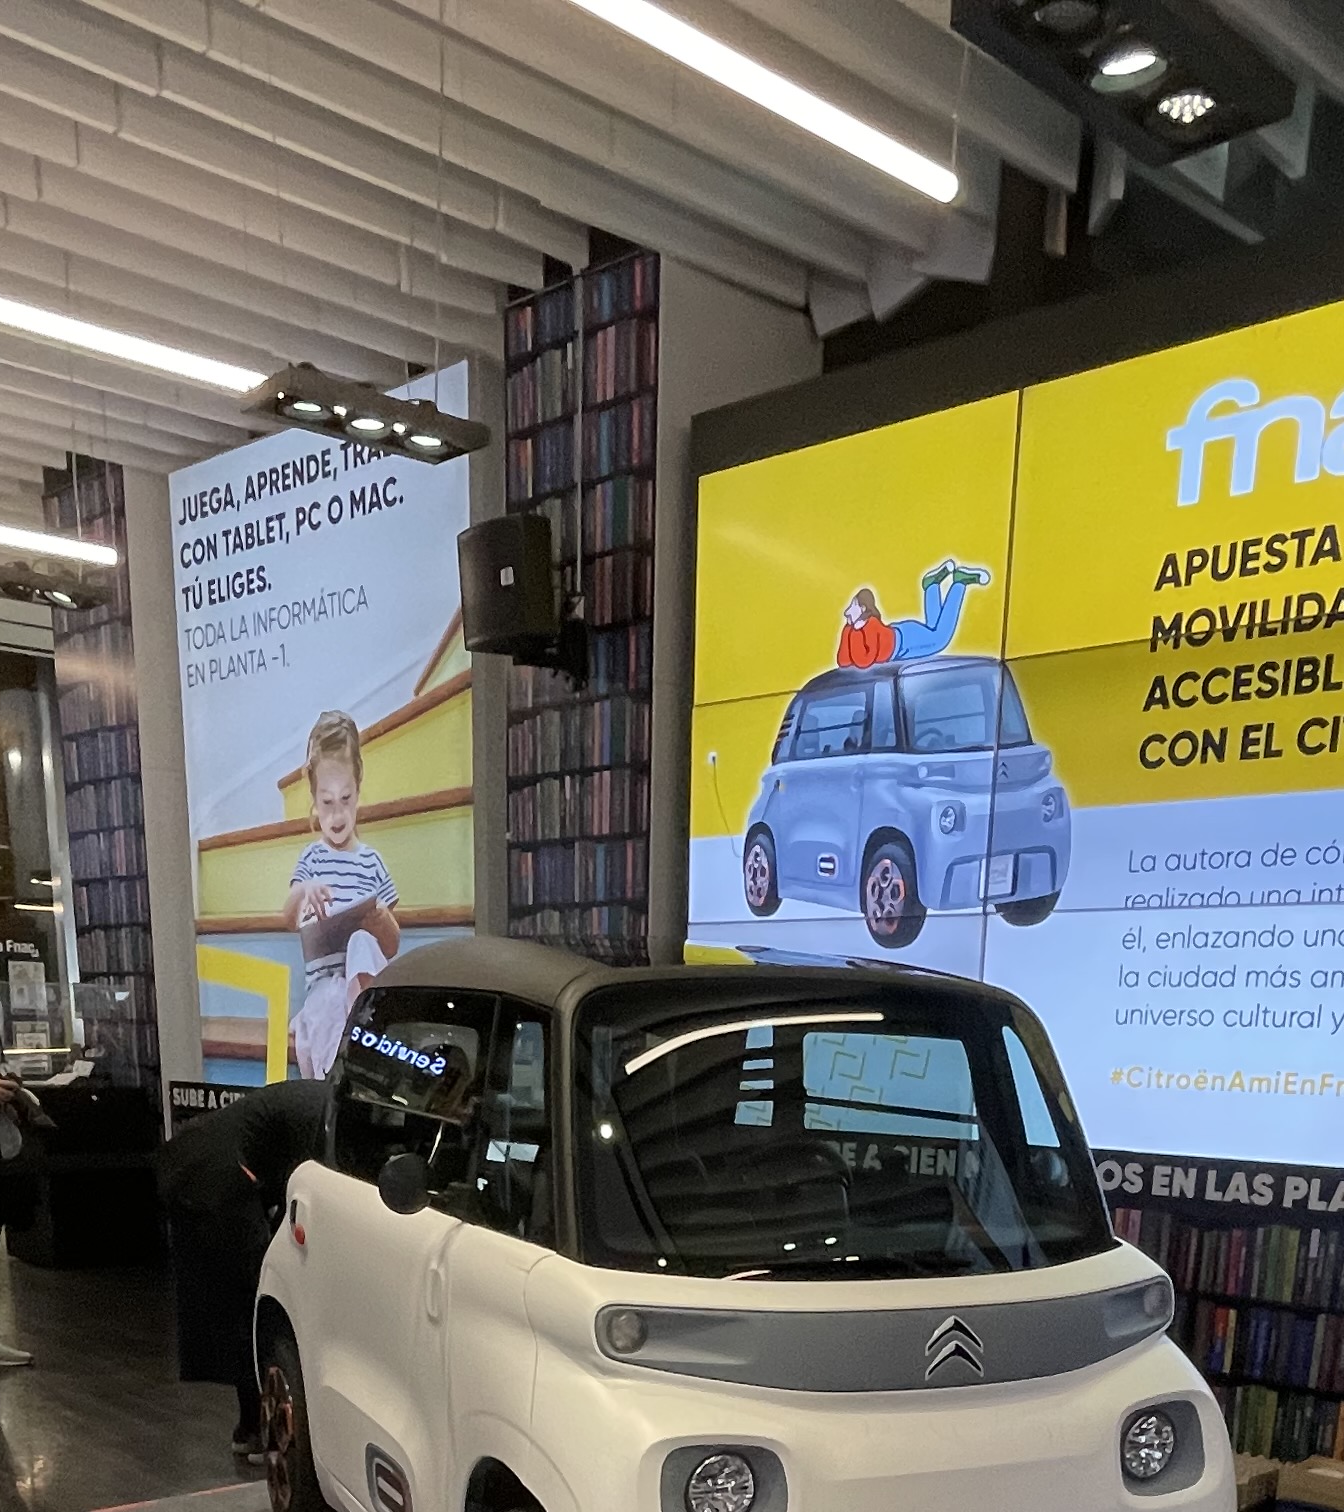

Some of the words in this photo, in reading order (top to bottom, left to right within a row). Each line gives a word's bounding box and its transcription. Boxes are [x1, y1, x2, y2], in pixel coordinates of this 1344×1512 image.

[178, 482, 240, 526] JUEGA,
[244, 448, 338, 505] APRENDE,
[180, 533, 218, 569] CON
[222, 511, 290, 555] TABLET,
[295, 502, 322, 536] PC
[327, 495, 344, 525] O
[350, 476, 404, 519] MAC.
[1154, 524, 1341, 592] APUESTA
[181, 577, 204, 613] TÚ
[208, 565, 272, 606] ELIGES.
[184, 622, 227, 652] TODA
[230, 614, 250, 642] LA
[253, 585, 369, 637] INFORMÁTICA
[186, 664, 205, 688] EN
[209, 648, 267, 684] PLANTA
[1139, 726, 1229, 770] CON
[1240, 722, 1282, 761] EL
[1128, 850, 1156, 874] La
[1165, 848, 1252, 872] autora
[1261, 842, 1297, 868] de
[1124, 885, 1241, 909] realizado
[1250, 889, 1302, 906] una
[1122, 926, 1146, 953] él,
[1156, 924, 1294, 949] enlazando
[1119, 964, 1140, 988] la
[1147, 964, 1236, 989] ciudad
[1245, 964, 1302, 989] más
[1115, 1003, 1215, 1027] universo
[1223, 1003, 1322, 1028] cultural
[172, 1087, 205, 1108] SUBE
[207, 1090, 218, 1110] A
[1097, 1159, 1144, 1197] OS
[1150, 1165, 1197, 1199] EN
[1205, 1169, 1274, 1208] LAS
